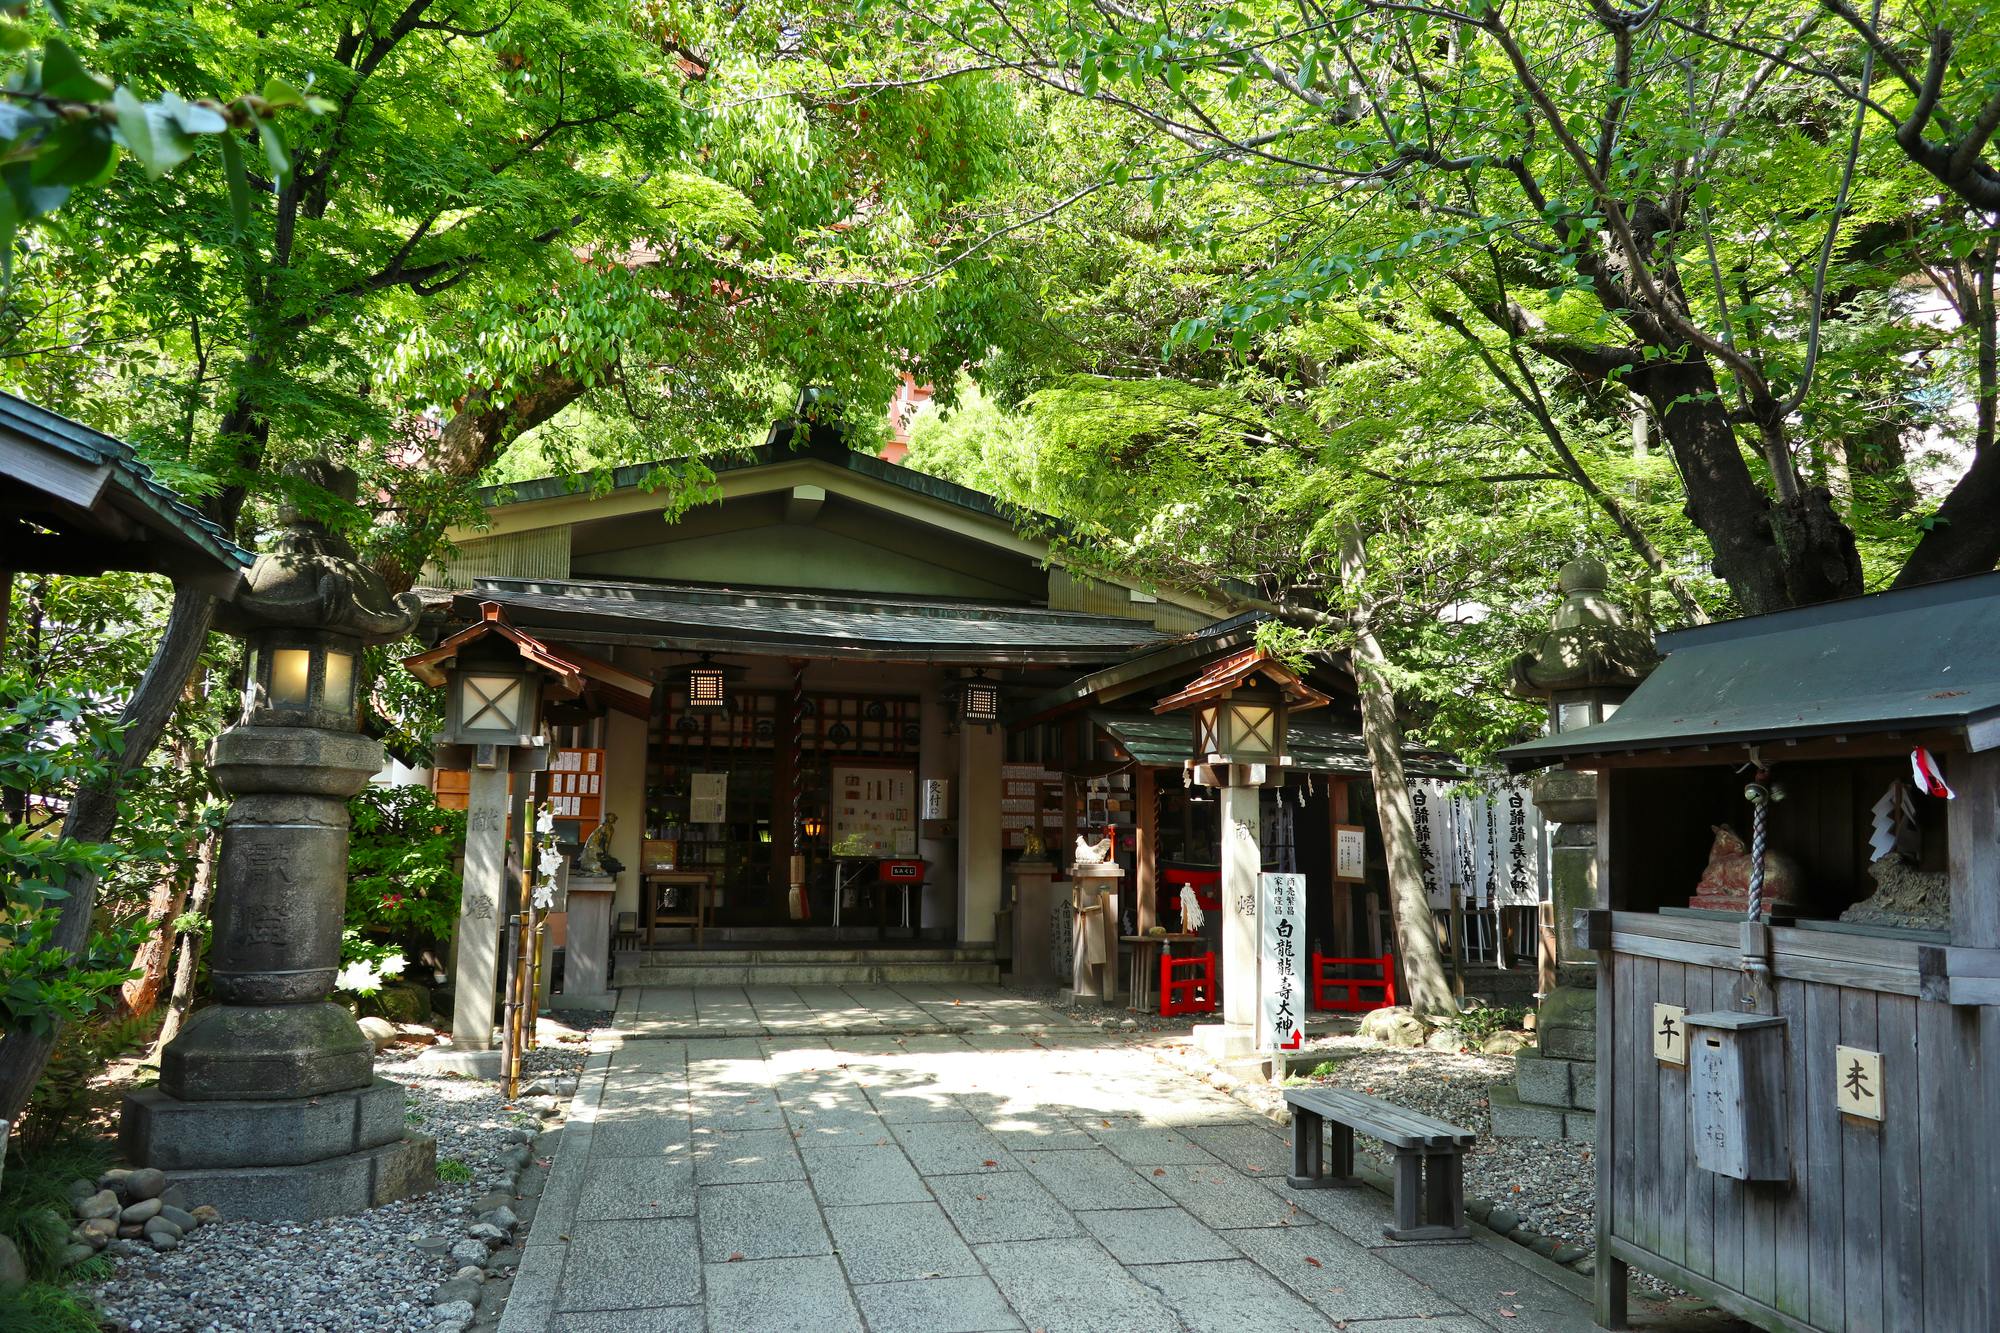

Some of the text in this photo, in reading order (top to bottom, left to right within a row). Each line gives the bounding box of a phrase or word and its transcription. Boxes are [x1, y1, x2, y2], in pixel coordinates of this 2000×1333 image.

[930, 781, 941, 806] 受付
[1273, 876, 1283, 915] 家内隆昌
[1286, 877, 1296, 916] 商売繁昌
[1658, 1014, 1680, 1050] 午
[1843, 1057, 1875, 1101] 未
